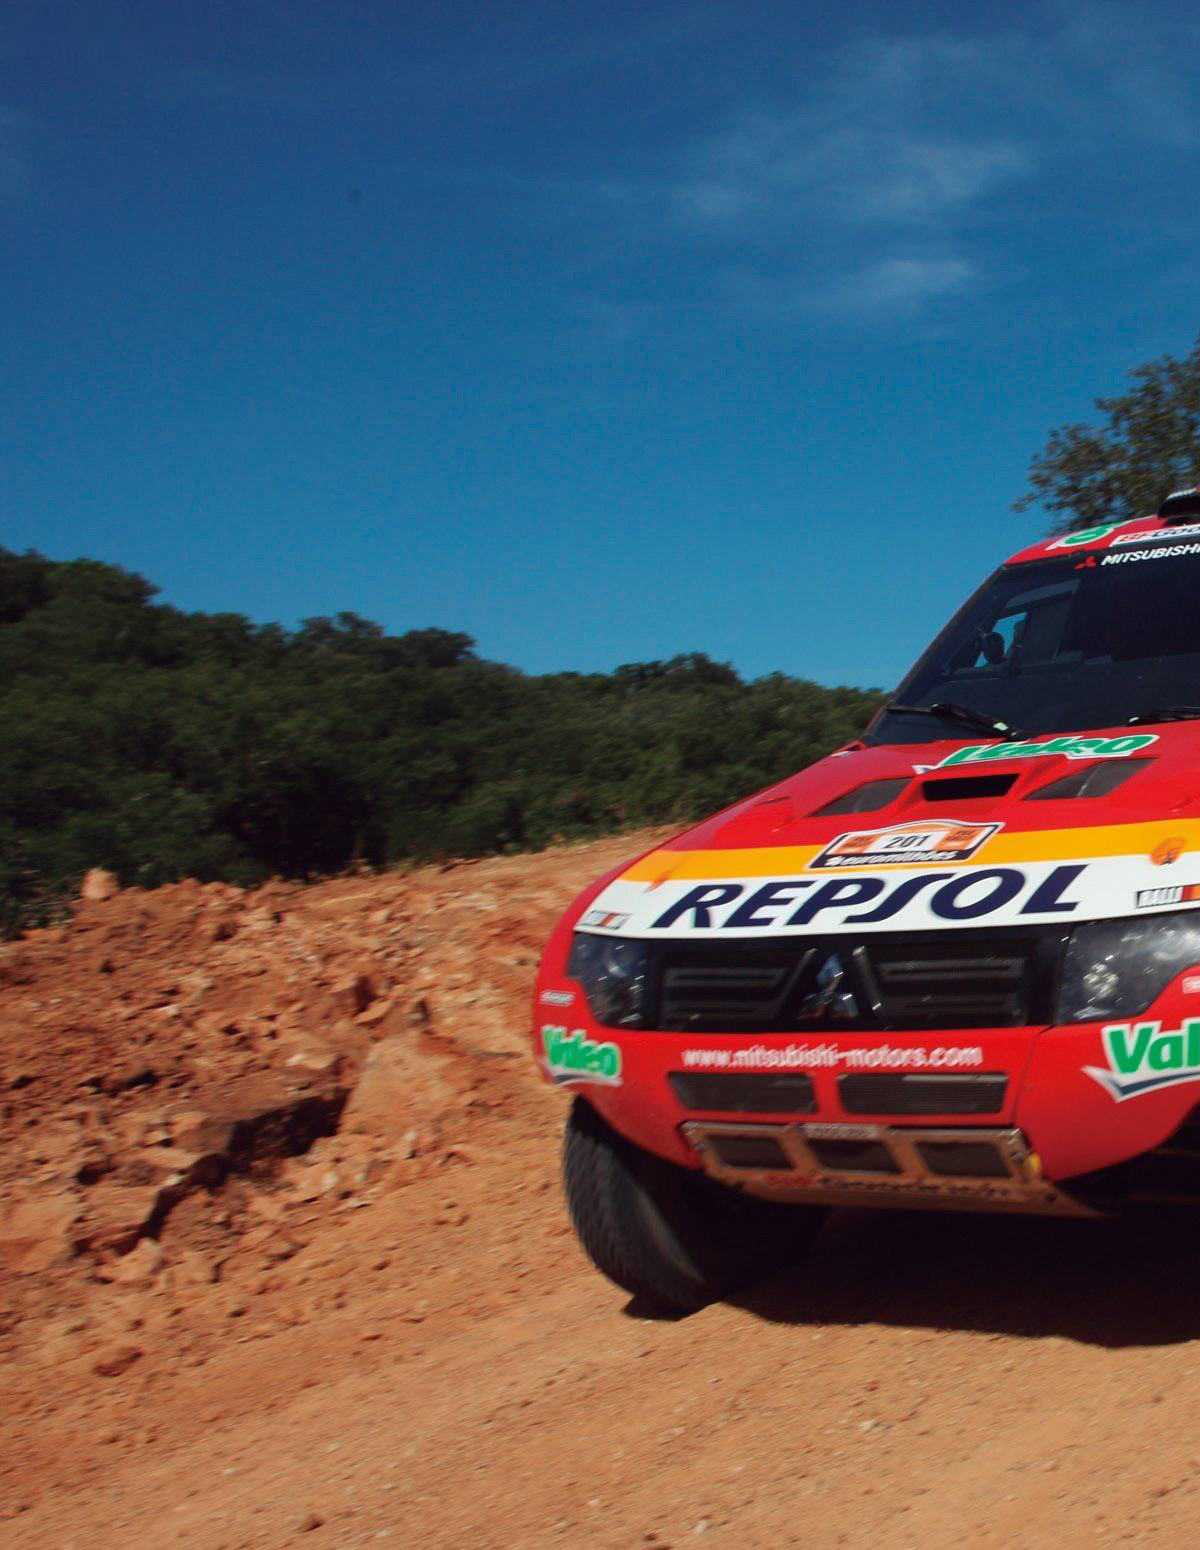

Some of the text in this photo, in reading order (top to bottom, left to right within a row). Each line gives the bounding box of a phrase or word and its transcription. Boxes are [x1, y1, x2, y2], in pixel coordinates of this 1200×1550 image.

[940, 734, 1160, 767] Valeo
[885, 834, 934, 849] 201
[648, 864, 1091, 929] REPSOL
[543, 1026, 621, 1077] Valeo
[681, 1043, 984, 1068] www.mitsubishi-motors.com
